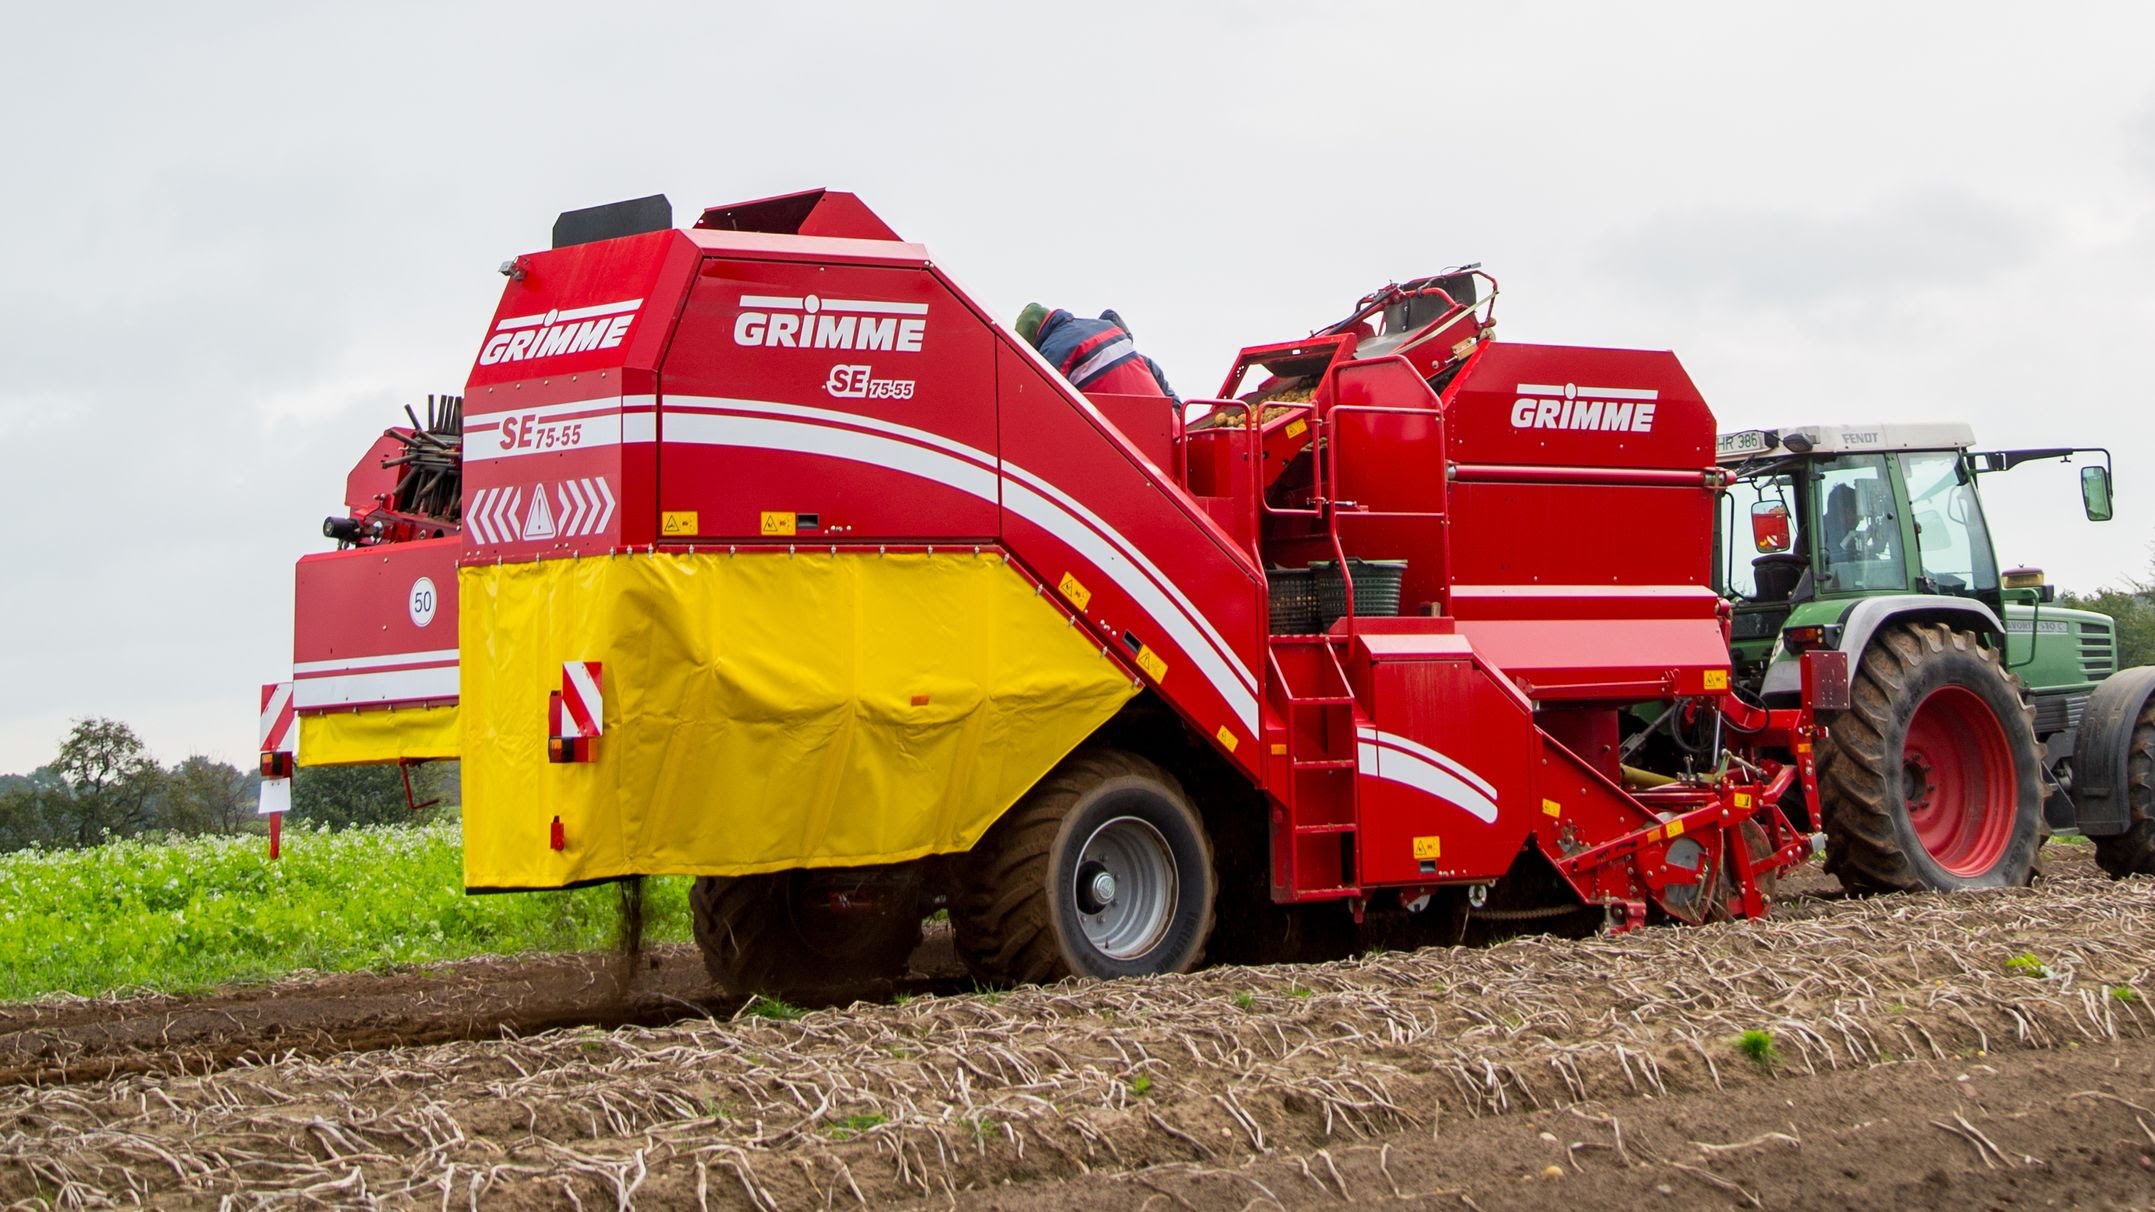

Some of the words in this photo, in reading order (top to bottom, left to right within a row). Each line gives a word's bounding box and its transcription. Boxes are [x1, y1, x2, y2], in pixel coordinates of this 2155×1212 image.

[479, 308, 636, 366] GRIMME
[733, 294, 927, 352] GRIMME
[828, 364, 872, 398] SE
[869, 379, 916, 399] 75-55
[1510, 382, 1657, 433] GRIMME
[500, 414, 536, 450] SE
[535, 423, 582, 449] 75-55
[1738, 432, 1758, 449] 386
[1841, 432, 1879, 444] FENDT
[414, 590, 432, 613] 50
